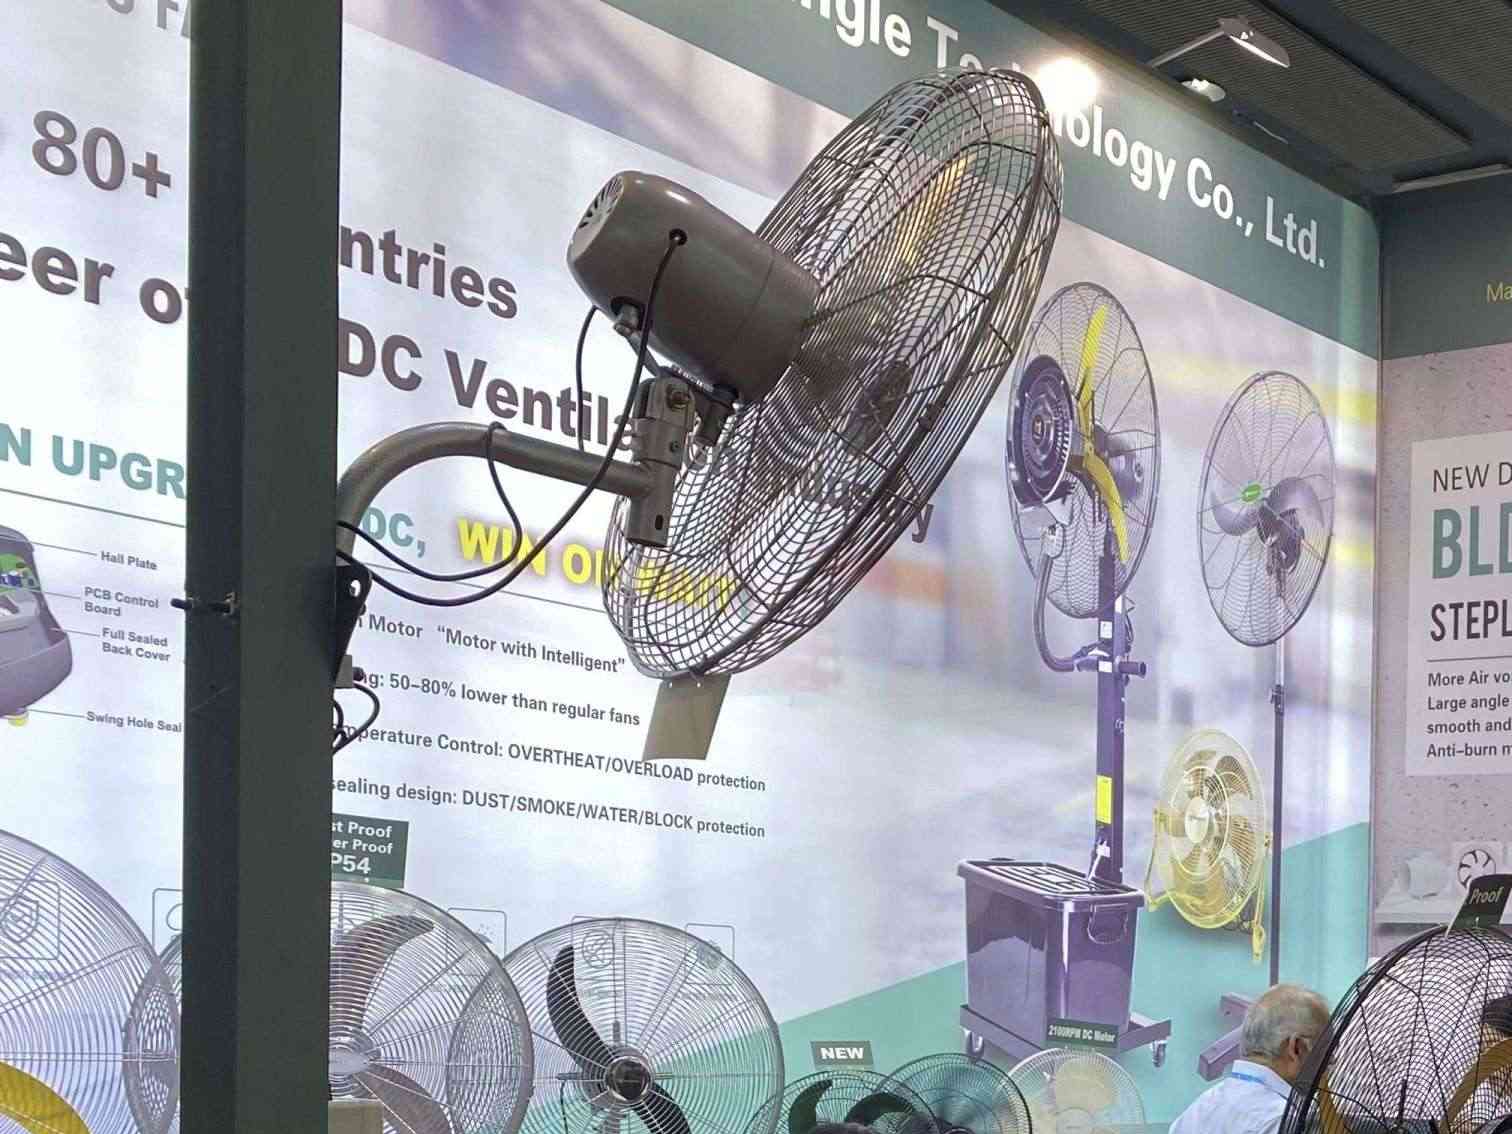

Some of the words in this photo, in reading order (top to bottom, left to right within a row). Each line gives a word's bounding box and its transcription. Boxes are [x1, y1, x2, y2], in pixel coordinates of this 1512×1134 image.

[32, 110, 171, 199] 80+
[1186, 157, 1252, 238] Co.,
[1265, 197, 1326, 268] Ltd.
[340, 224, 517, 319] ntries
[139, 277, 189, 324] o
[1433, 464, 1490, 492] NEW
[128, 555, 157, 570] Plate
[85, 586, 111, 601] PCB
[115, 591, 159, 609] Control
[85, 602, 121, 616] Board
[103, 628, 124, 641] Full
[129, 631, 168, 647] Sealed
[369, 614, 423, 638] Motor
[501, 637, 537, 659] with
[103, 642, 132, 656] Back
[136, 646, 171, 662] Cover
[1428, 671, 1464, 687] More
[1469, 670, 1489, 685] Air
[461, 683, 507, 705] lower
[511, 691, 548, 712] than
[551, 699, 605, 722] regular
[608, 707, 640, 726] fans
[1428, 695, 1467, 713] Large
[1471, 693, 1508, 711] angle
[86, 711, 123, 727] Swing
[127, 715, 154, 730] Hole
[1427, 719, 1481, 735] smooth
[1485, 717, 1511, 733] and
[437, 734, 503, 757] Control:
[507, 743, 694, 783] OVERTHEAT/OVERLOAD
[697, 770, 766, 792] protection
[396, 783, 457, 805] design:
[462, 789, 693, 830] DUST/SMOKE/WATER/BLOCK
[696, 817, 766, 839] protection
[347, 821, 392, 838] Proof
[352, 838, 393, 854] Proof
[1469, 886, 1505, 905] Proof
[820, 1047, 865, 1060] NEW
